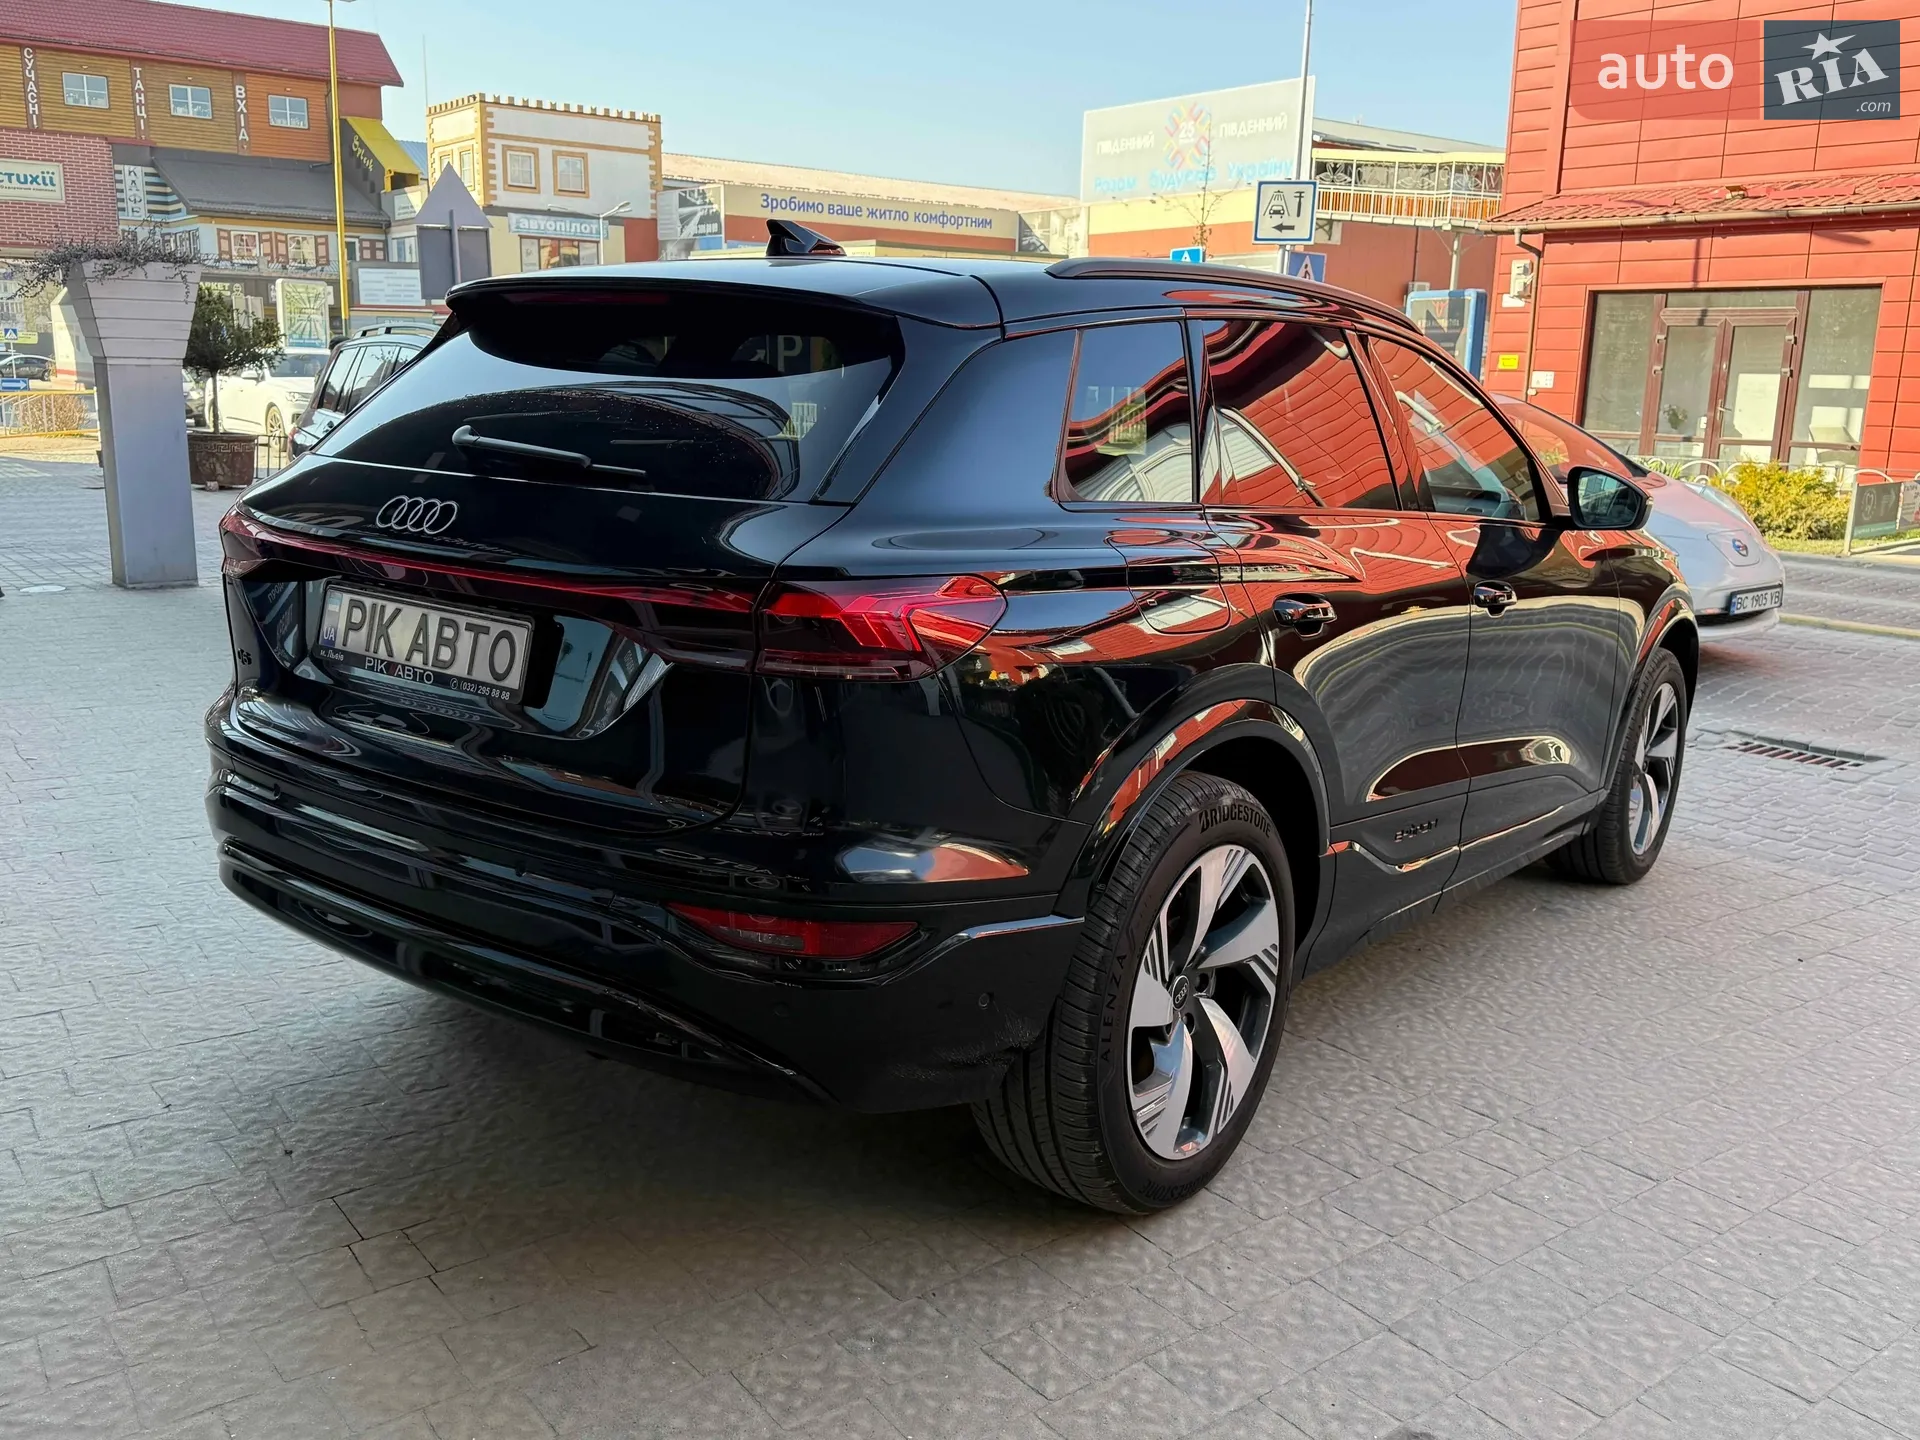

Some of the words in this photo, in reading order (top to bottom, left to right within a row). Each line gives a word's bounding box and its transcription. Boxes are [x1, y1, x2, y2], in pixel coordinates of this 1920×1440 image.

[24, 48, 39, 126] СУЧАСНІ
[133, 67, 146, 130] ТАНЦІ
[1219, 112, 1288, 138] ПІВДЕННИЙ
[1096, 131, 1155, 155] ПІВДЕННИЙ
[760, 193, 824, 213] Зробимо
[828, 203, 863, 217] ваше
[866, 207, 909, 222] житло
[914, 211, 993, 230] комфортним
[520, 218, 598, 234] автопілот
[1750, 592, 1768, 608] 1905
[323, 626, 335, 641] UA
[460, 681, 478, 693] (032)
[478, 685, 490, 696] 295
[491, 688, 500, 698] 88
[500, 690, 510, 700] 88
[1198, 803, 1271, 838] BRIDGESTONE
[1102, 953, 1127, 1062] ALENZA
